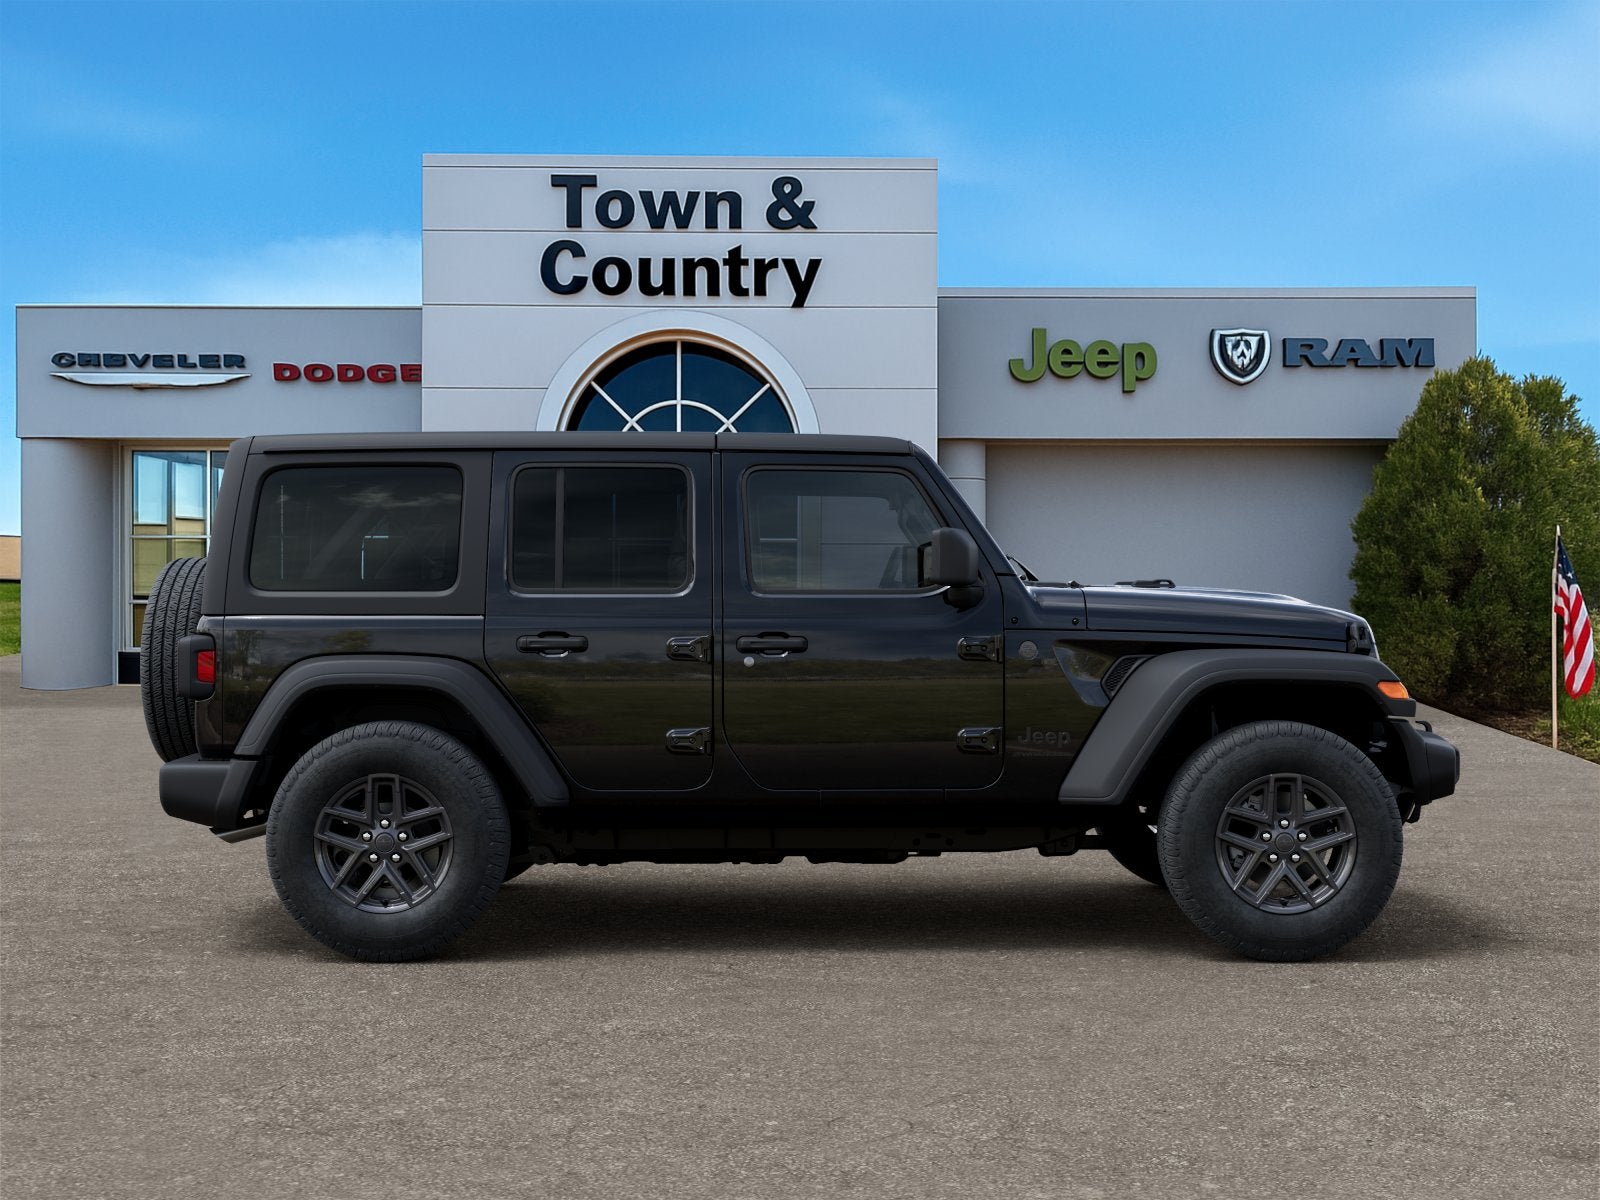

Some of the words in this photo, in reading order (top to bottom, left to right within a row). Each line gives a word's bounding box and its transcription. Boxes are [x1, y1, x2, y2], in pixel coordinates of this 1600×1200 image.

[550, 174, 742, 229] Town
[765, 176, 818, 229] &
[540, 239, 822, 308] Country
[273, 362, 422, 383] DODGE
[1009, 328, 1157, 392] Jeep
[1283, 338, 1435, 368] RAM
[1018, 727, 1071, 748] Jeep
